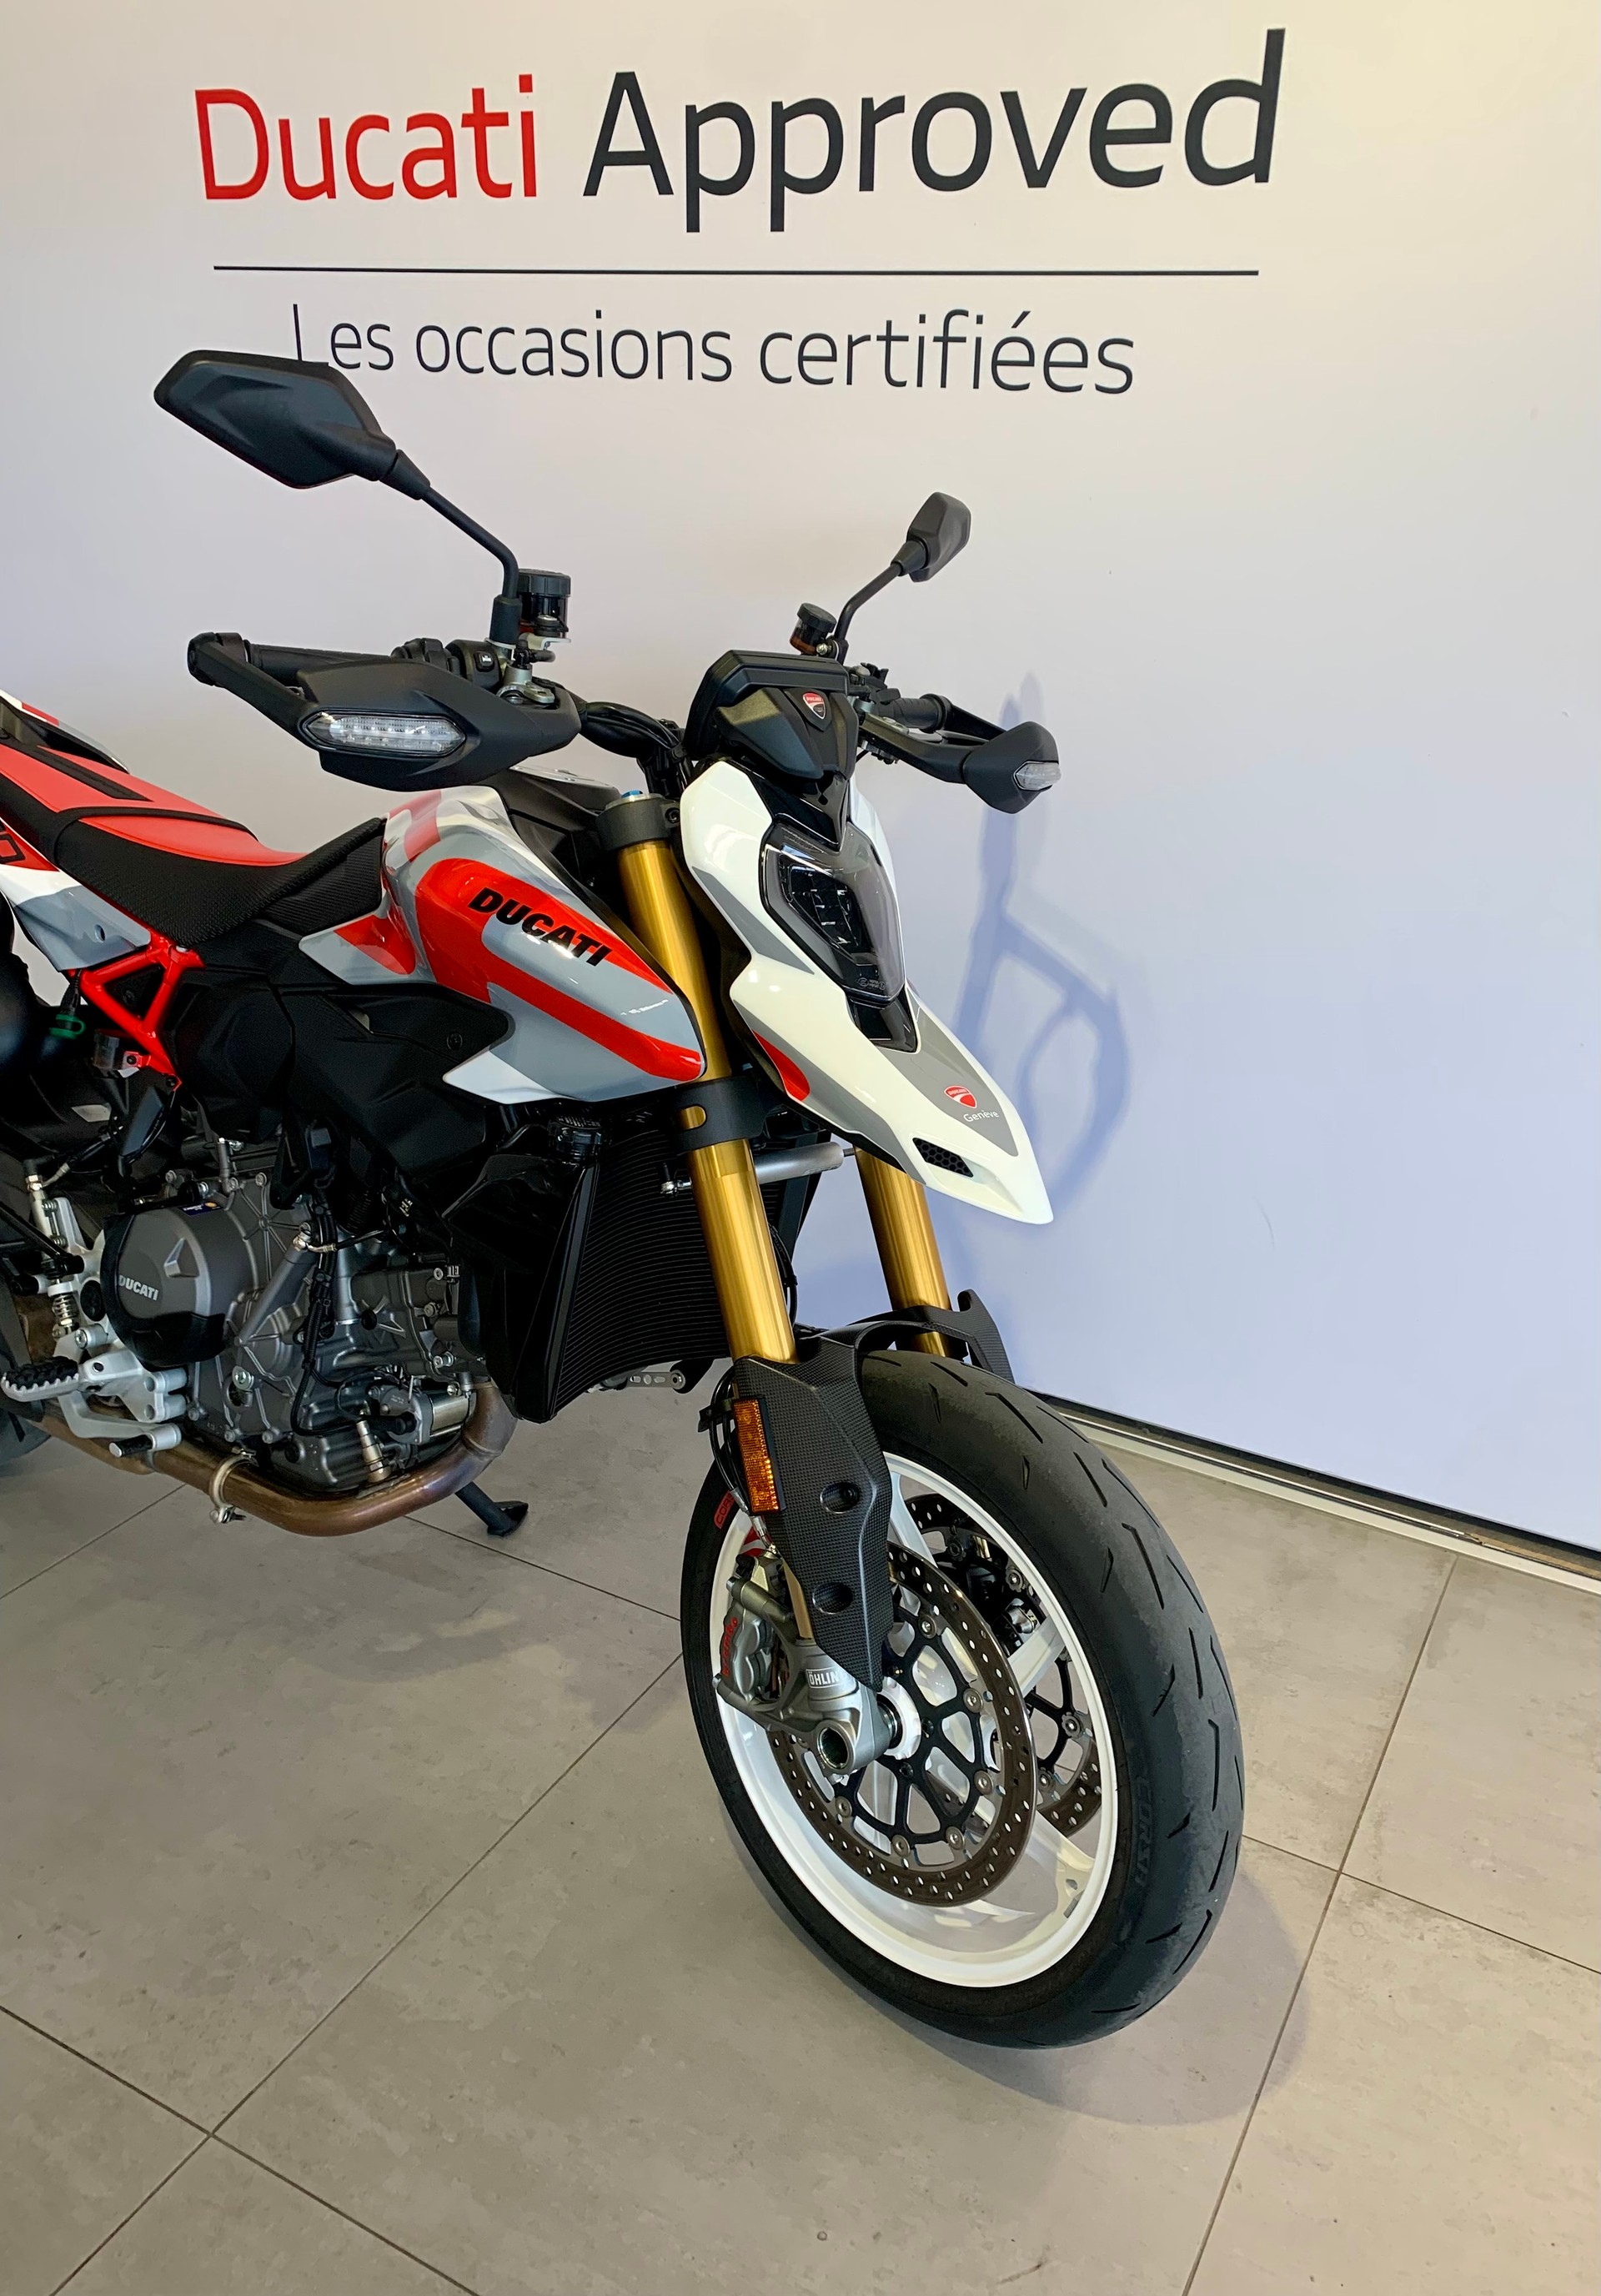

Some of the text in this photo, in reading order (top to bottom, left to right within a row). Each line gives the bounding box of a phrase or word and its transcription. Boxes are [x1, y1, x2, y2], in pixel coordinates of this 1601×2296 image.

[194, 28, 1286, 233] Ducati Approved
[292, 303, 1135, 394] Les occasions certifiées
[467, 887, 613, 967] DUCATI
[963, 1109, 1000, 1123] Genève
[118, 1274, 159, 1301] DUCATI
[807, 1671, 842, 1686] ÖHLIN
